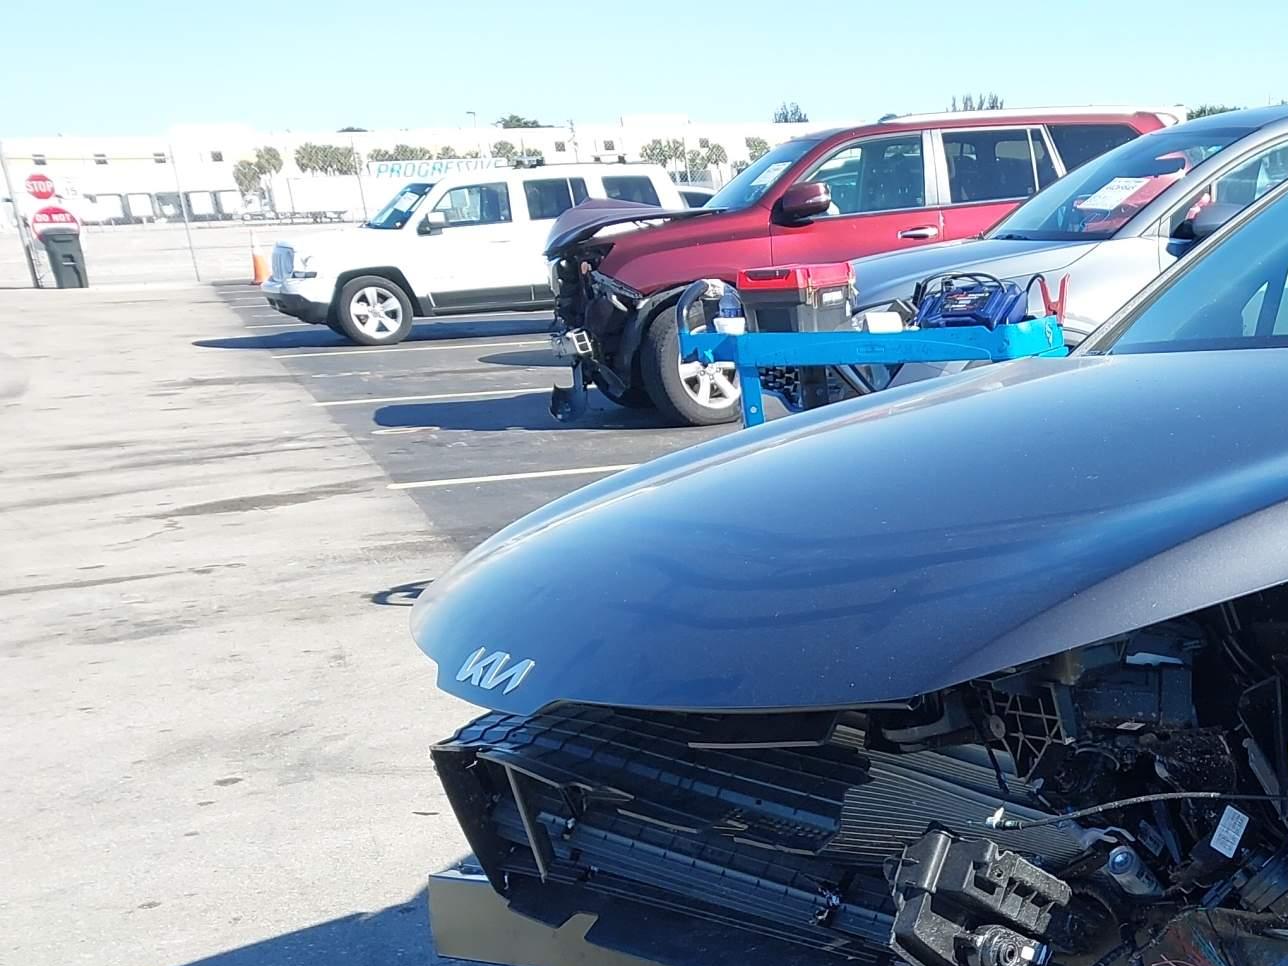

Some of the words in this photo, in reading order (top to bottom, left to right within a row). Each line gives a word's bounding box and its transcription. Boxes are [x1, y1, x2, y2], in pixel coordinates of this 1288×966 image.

[26, 180, 54, 193] STOP
[51, 213, 71, 222] NOT
[455, 646, 536, 695] KIA
